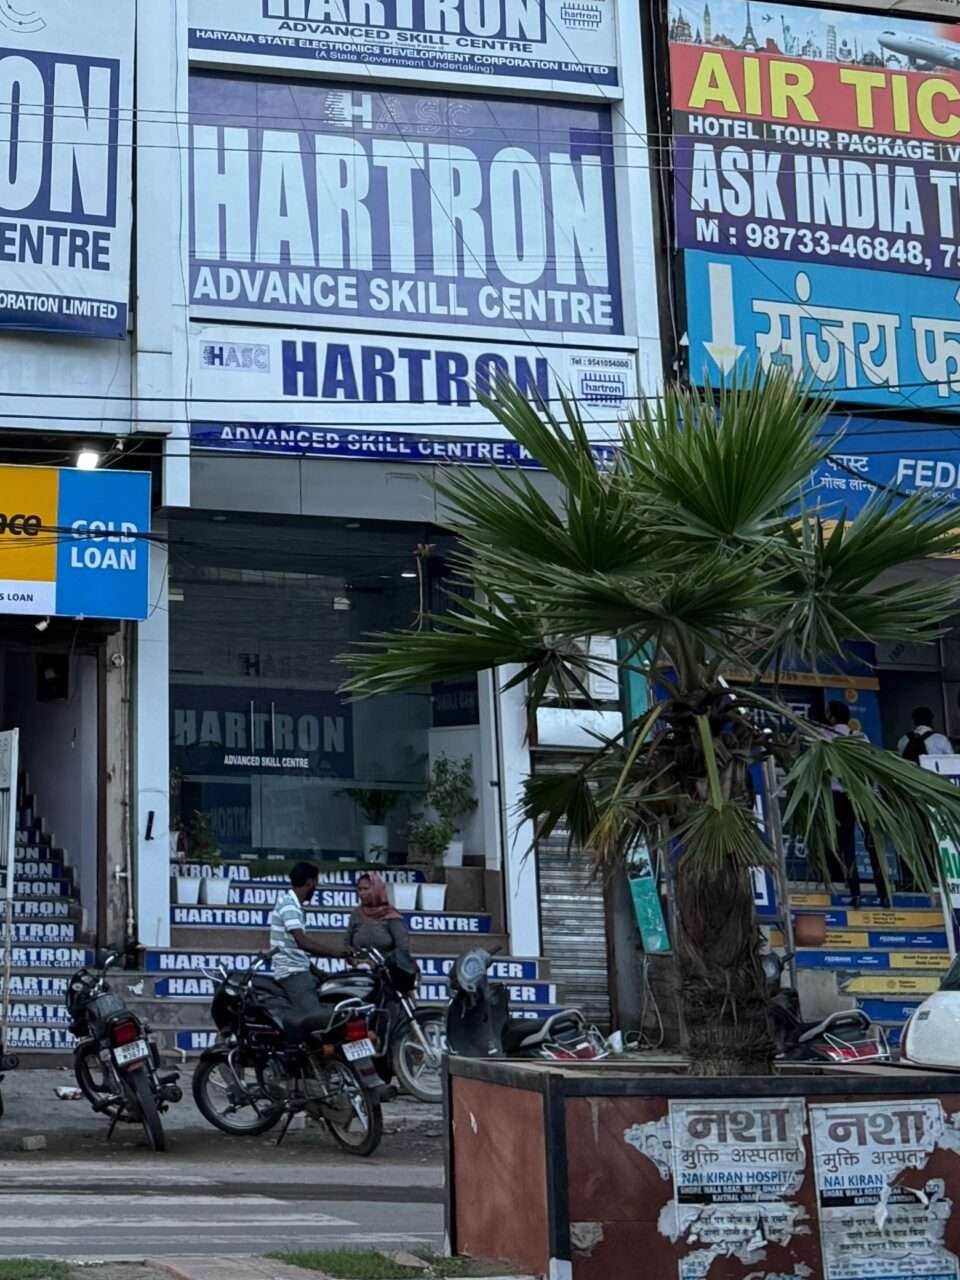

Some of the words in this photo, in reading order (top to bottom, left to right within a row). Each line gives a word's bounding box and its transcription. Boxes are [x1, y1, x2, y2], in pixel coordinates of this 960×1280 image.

[563, 10, 599, 20] hartron
[278, 21, 395, 41] ADVANCED
[396, 32, 450, 46] SKILL
[455, 39, 533, 54] CENTRE
[196, 30, 255, 44] HARYANA
[258, 36, 296, 48] STATE
[299, 39, 380, 55] ELECTRONICS
[383, 46, 471, 63] DEVELOPMENT
[474, 55, 559, 71] CORPORATION
[562, 63, 609, 75] LIMITED
[360, 54, 425, 68] Government
[687, 51, 821, 123] AIR
[688, 114, 760, 141] HOTEL
[771, 125, 831, 150] TOUR
[836, 131, 936, 161] PACKAGE
[690, 142, 787, 222] ASK
[794, 154, 926, 236] INDIA
[192, 123, 610, 288] HARTRON
[62, 299, 118, 320] LIMITED
[192, 266, 358, 309] ADVANCE
[369, 277, 469, 318] SKILL
[478, 285, 615, 327] CENTRE
[751, 271, 901, 393] संजय
[584, 382, 622, 395] hartron
[220, 425, 342, 450] ADVANCED
[347, 433, 412, 455] SKILL
[70, 546, 138, 571] LOAN
[7, 593, 35, 603] LOAN
[224, 754, 260, 767] ADVANCED
[262, 755, 281, 768] SKILL
[282, 756, 309, 769] CENTRE
[174, 908, 264, 926] HARTRON
[410, 916, 480, 932] CENTRE
[685, 1108, 790, 1144] नशा
[825, 1110, 927, 1147] नशा
[681, 1144, 720, 1169] मुक्ति
[730, 1146, 801, 1163] अस्पताल
[822, 1147, 860, 1173] मुक्ति
[681, 1172, 703, 1185] NAI
[706, 1171, 744, 1184] KIRAN
[824, 1175, 845, 1188] NAI
[848, 1173, 884, 1187] KIRAN
